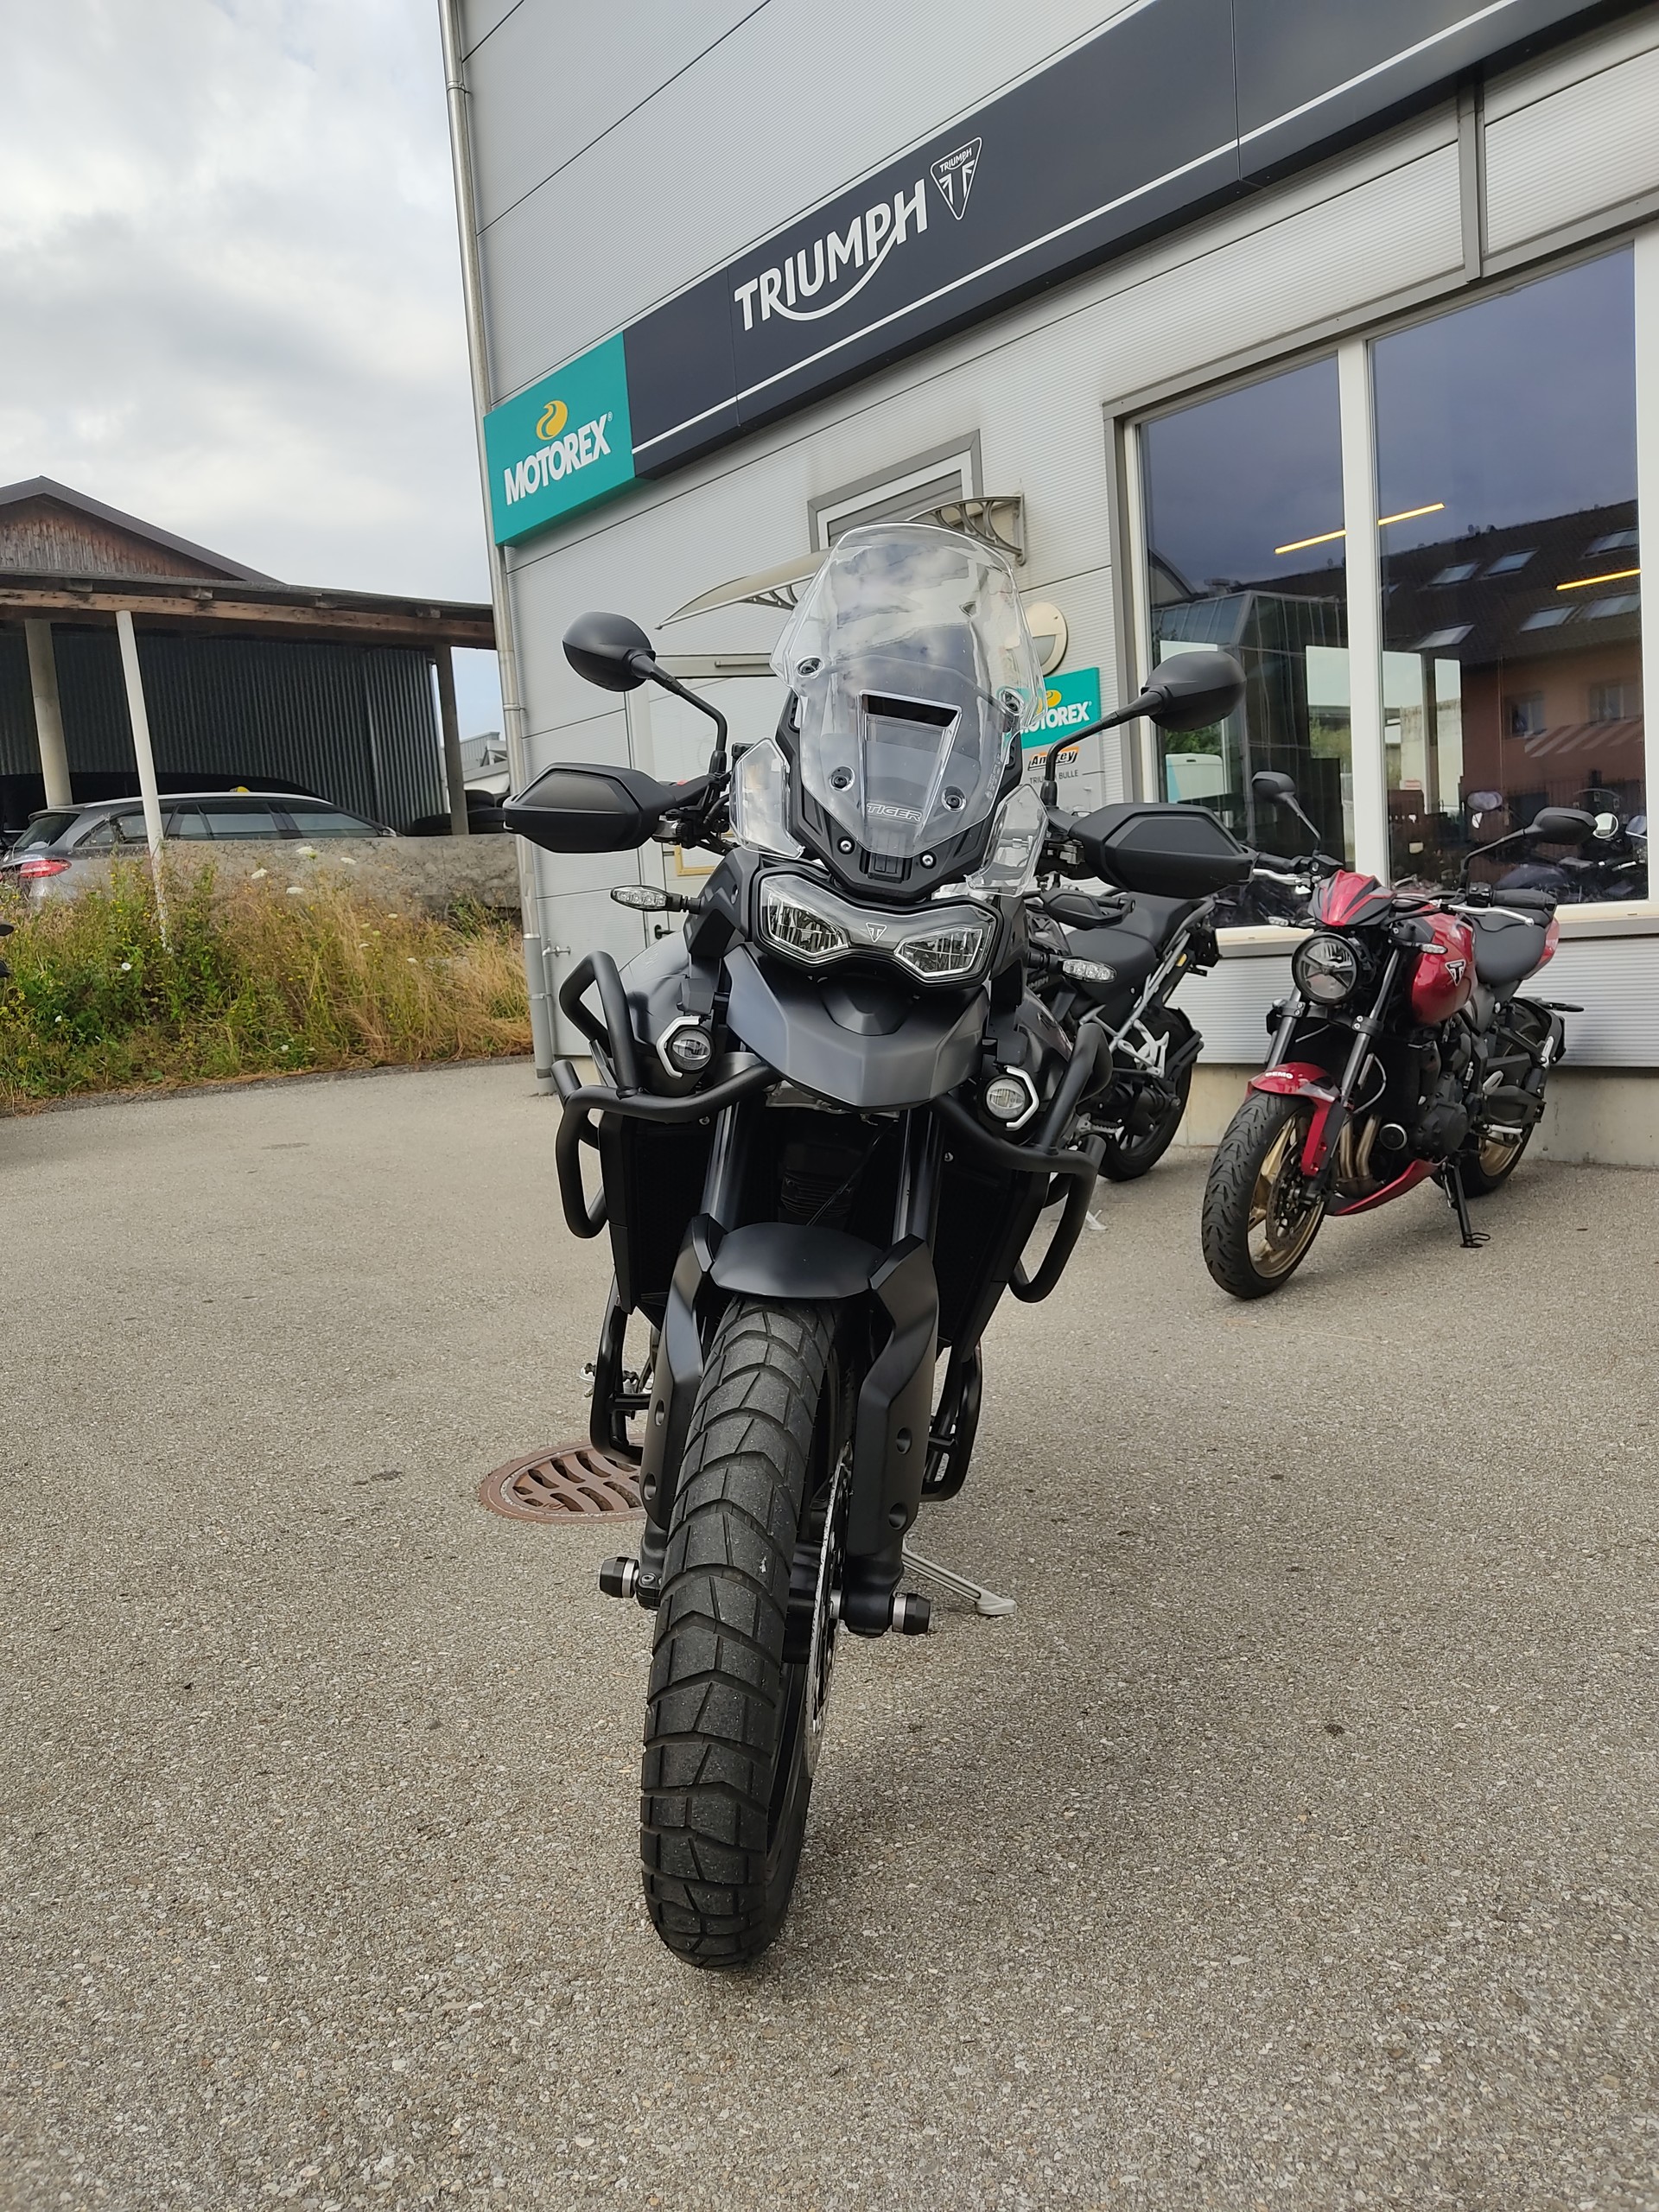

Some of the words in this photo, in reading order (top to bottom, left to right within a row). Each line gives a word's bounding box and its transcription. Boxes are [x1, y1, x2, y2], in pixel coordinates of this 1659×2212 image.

[939, 147, 972, 173] TRIUMPH
[734, 178, 928, 331] TRIUMPH
[1058, 769, 1079, 779] BULLE
[867, 803, 923, 823] TIGER
